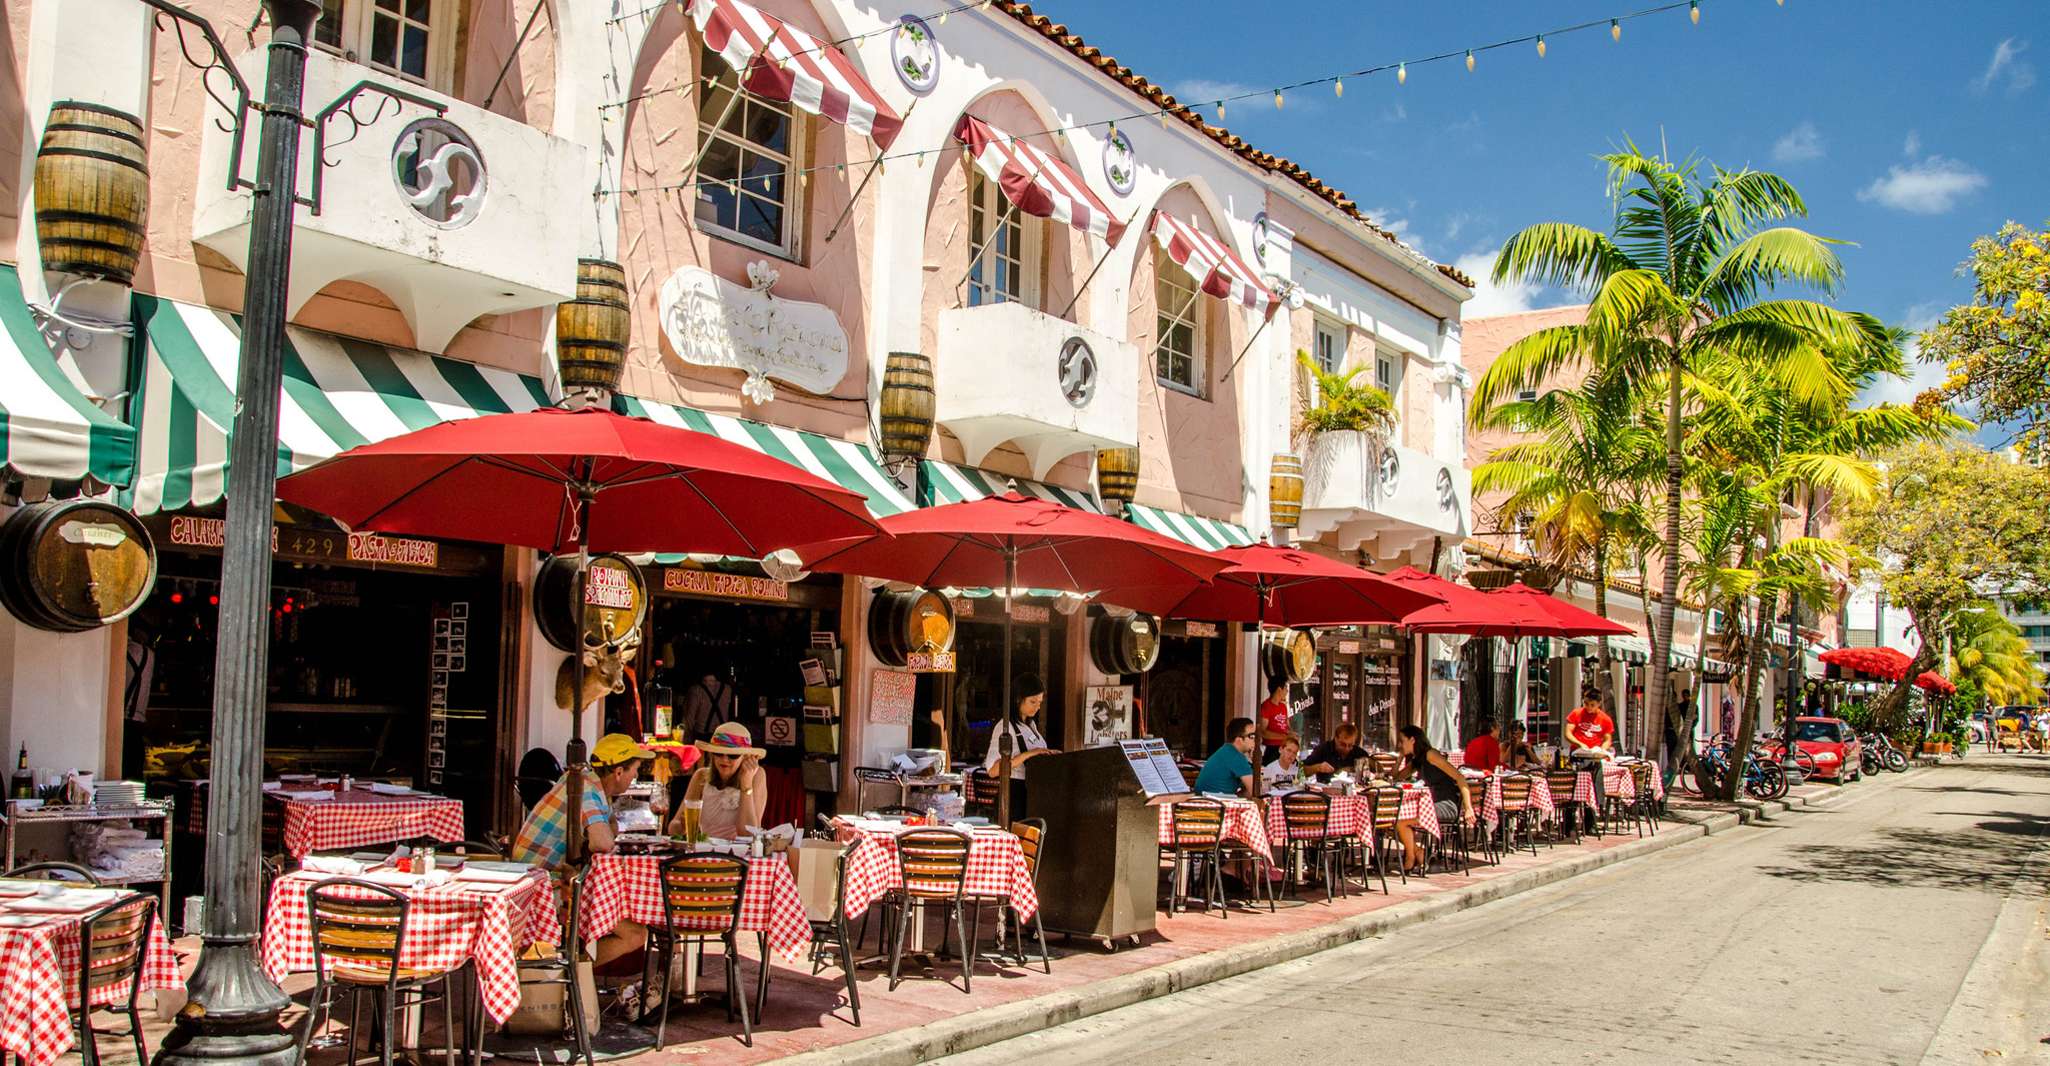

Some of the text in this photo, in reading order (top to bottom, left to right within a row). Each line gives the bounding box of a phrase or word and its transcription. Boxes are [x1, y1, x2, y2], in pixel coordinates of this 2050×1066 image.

[291, 536, 333, 556] 429
[348, 533, 391, 561] PASTA
[665, 568, 710, 592] CUCINA
[713, 573, 750, 596] TIPICA
[1096, 687, 1124, 702] Maine
